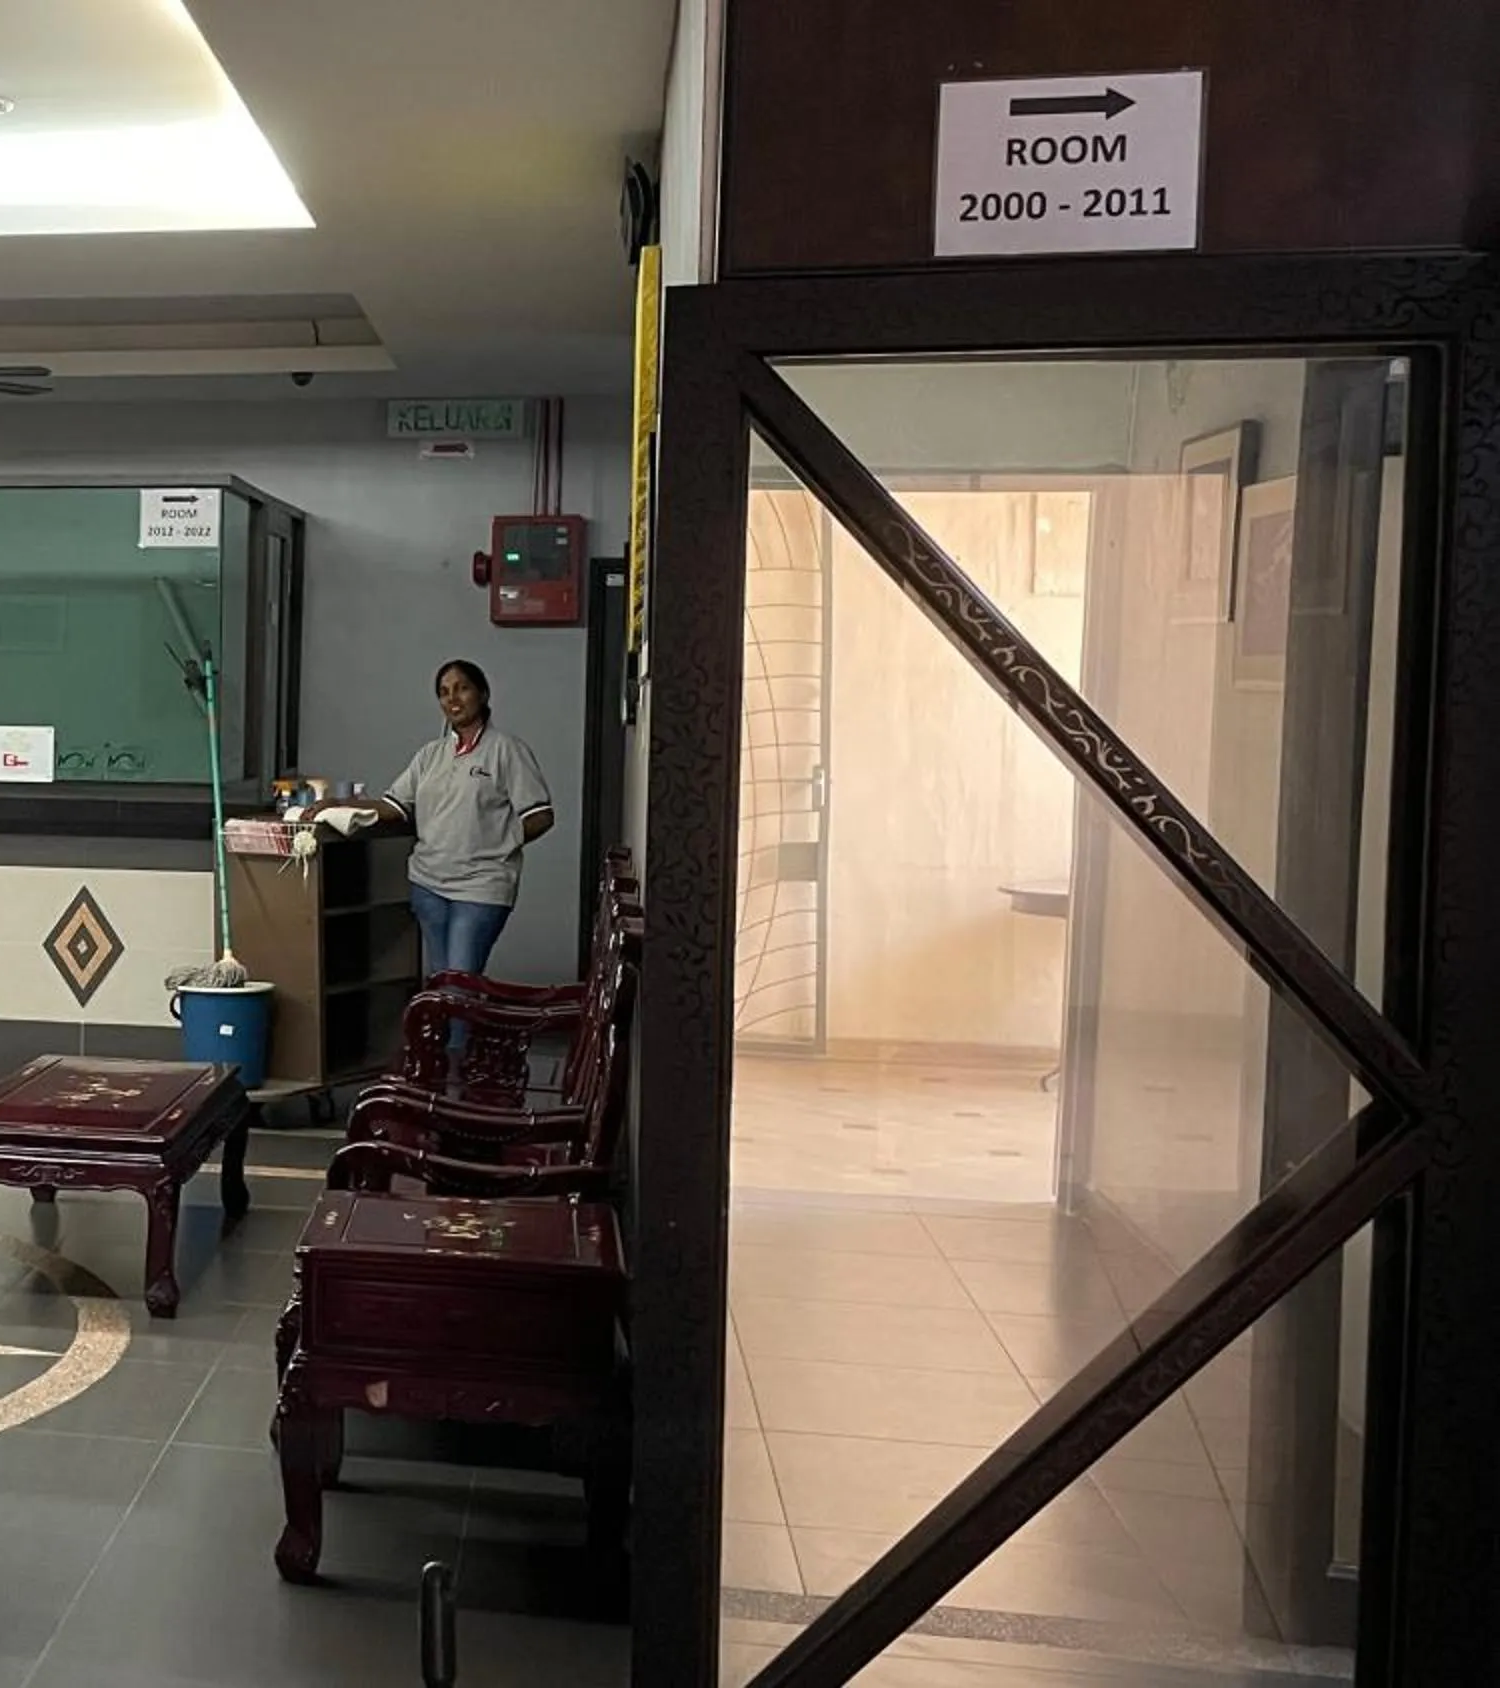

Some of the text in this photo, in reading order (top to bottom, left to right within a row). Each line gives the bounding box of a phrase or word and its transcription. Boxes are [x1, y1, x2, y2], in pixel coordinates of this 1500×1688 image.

[1005, 134, 1128, 166] ROOM
[958, 191, 1048, 222] 2000
[1082, 187, 1171, 218] 2011
[161, 508, 198, 519] ROOM
